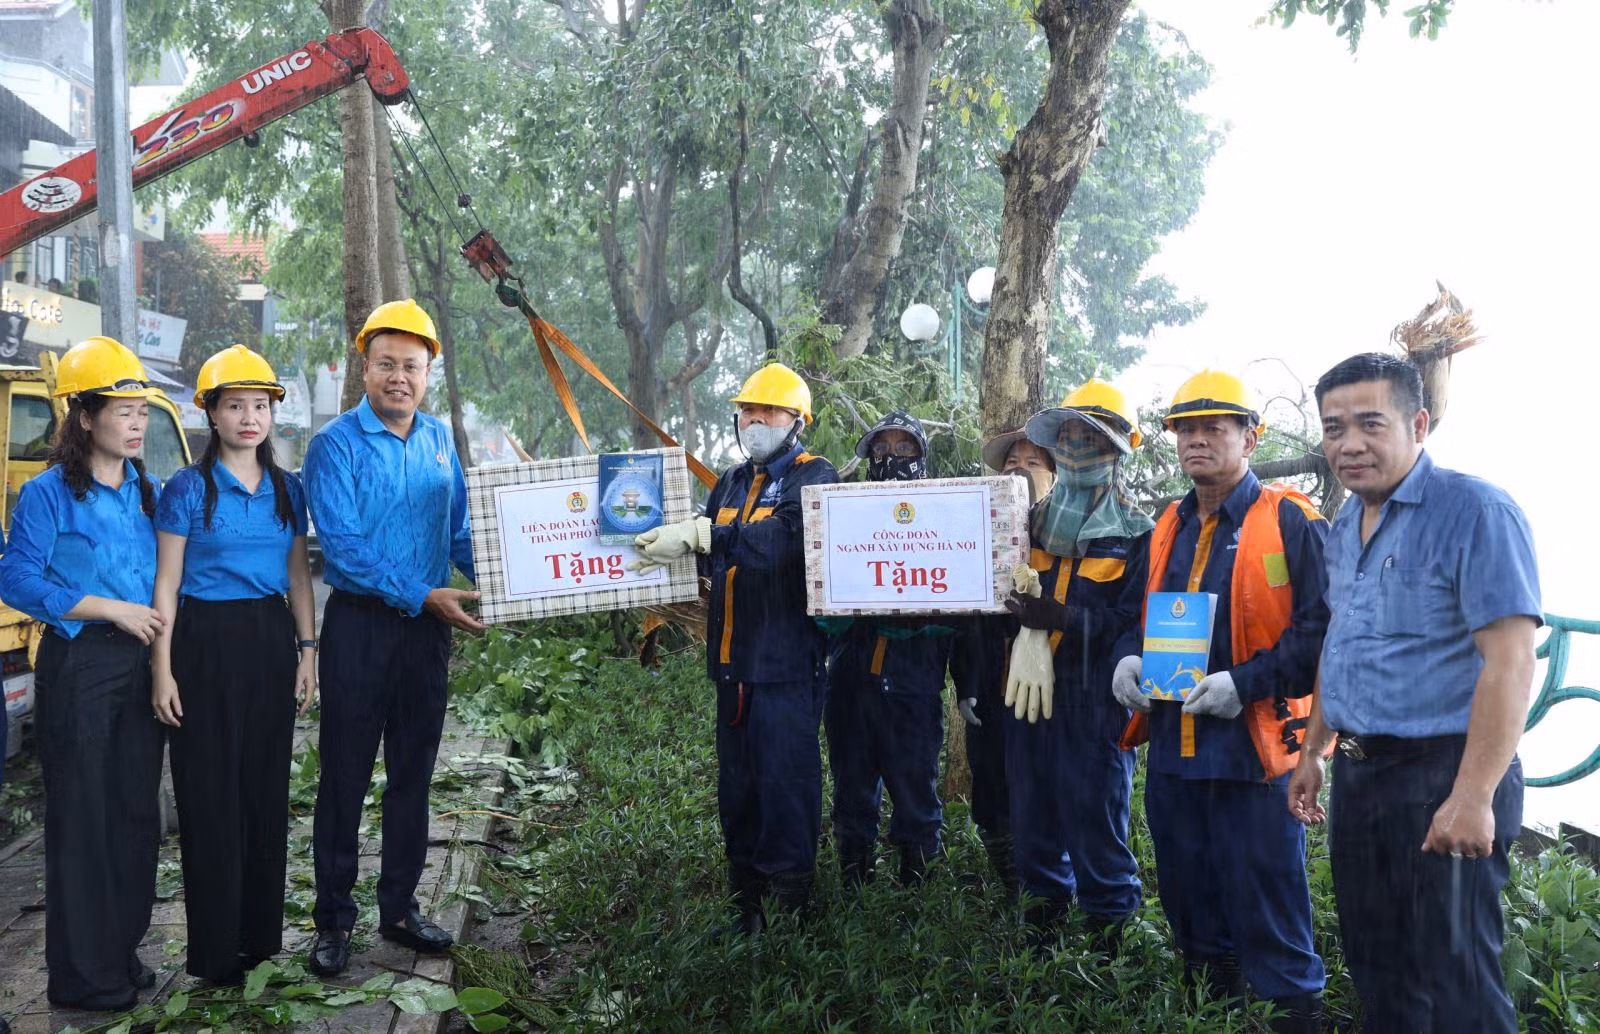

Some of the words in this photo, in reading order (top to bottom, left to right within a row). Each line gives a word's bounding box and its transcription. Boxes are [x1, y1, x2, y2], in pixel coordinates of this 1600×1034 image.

[241, 51, 312, 94] UNIC
[549, 518, 579, 531] ĐOÀN
[873, 529, 904, 540] CÔNG
[907, 528, 938, 539] ĐOÀN
[878, 541, 899, 551] XÂY
[903, 542, 935, 553] DỰNG
[938, 540, 953, 550] HÀ
[544, 551, 625, 584] Tặng
[867, 560, 948, 594] Tặng
